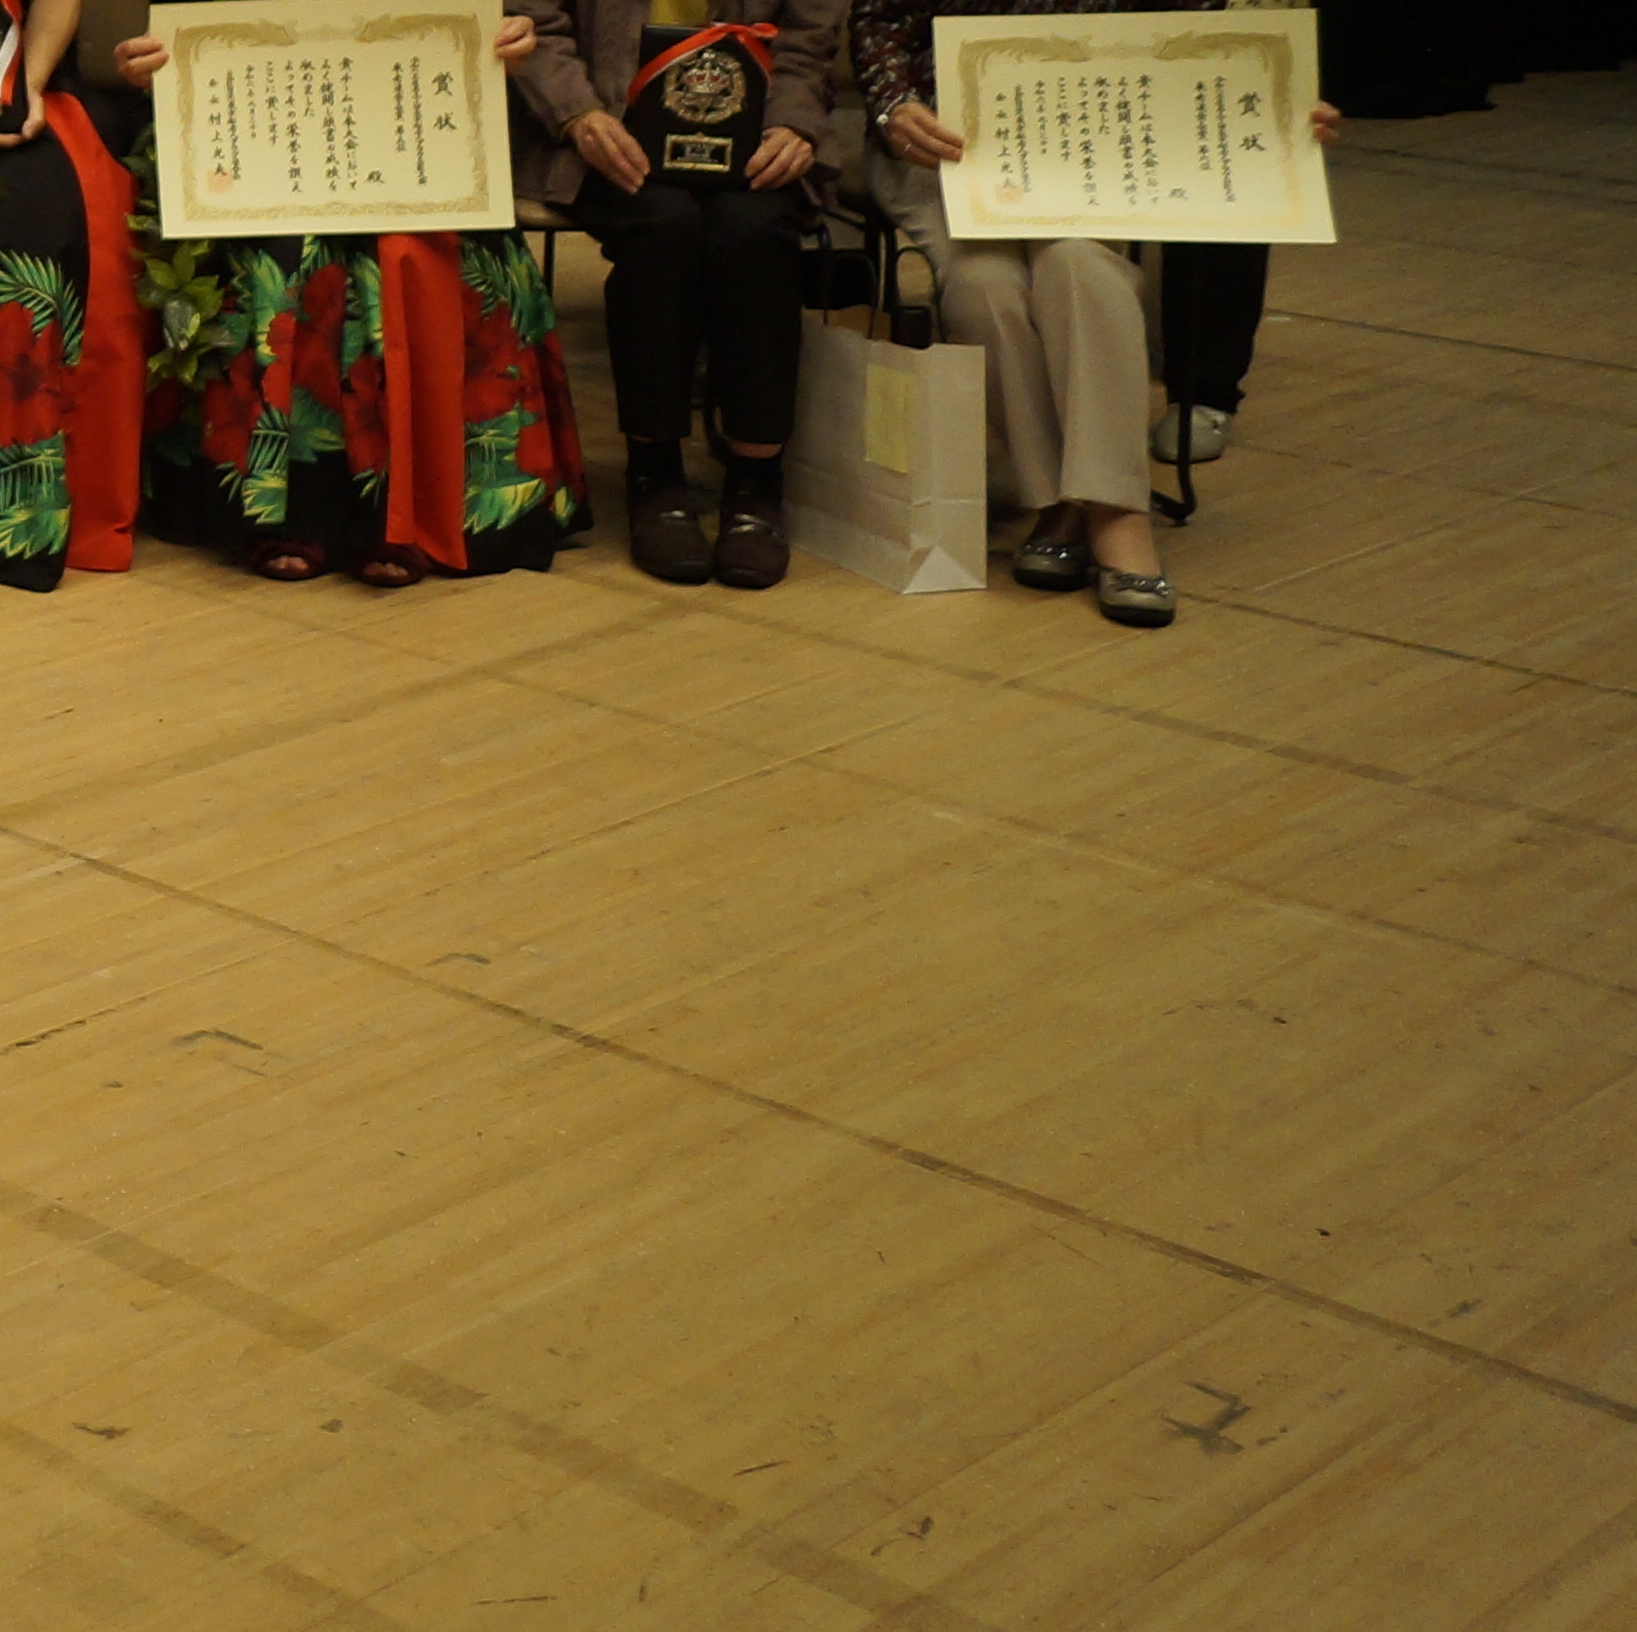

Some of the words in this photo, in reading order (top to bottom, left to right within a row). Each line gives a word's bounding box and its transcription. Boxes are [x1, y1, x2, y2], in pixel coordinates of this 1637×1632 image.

[431, 71, 458, 131] 賞状
[1237, 91, 1266, 152] 賞状
[366, 170, 385, 184] 殿
